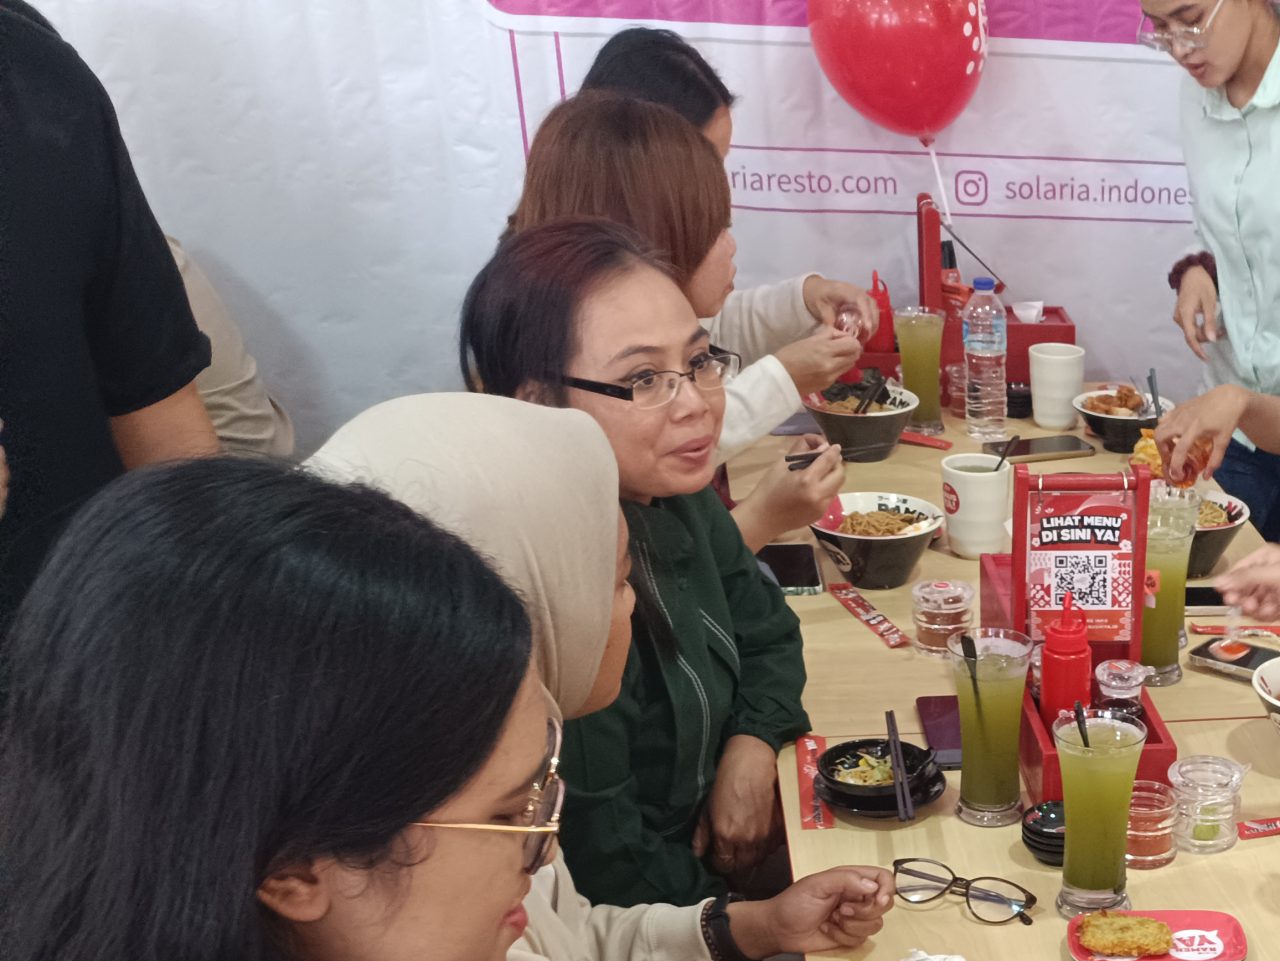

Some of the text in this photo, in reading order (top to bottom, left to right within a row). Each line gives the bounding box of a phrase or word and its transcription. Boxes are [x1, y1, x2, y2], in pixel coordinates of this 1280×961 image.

[1005, 174, 1193, 206] solaria.indone
[1042, 515, 1122, 528] LIHAT MENU
[1041, 529, 1120, 543] DI SINI YA!
